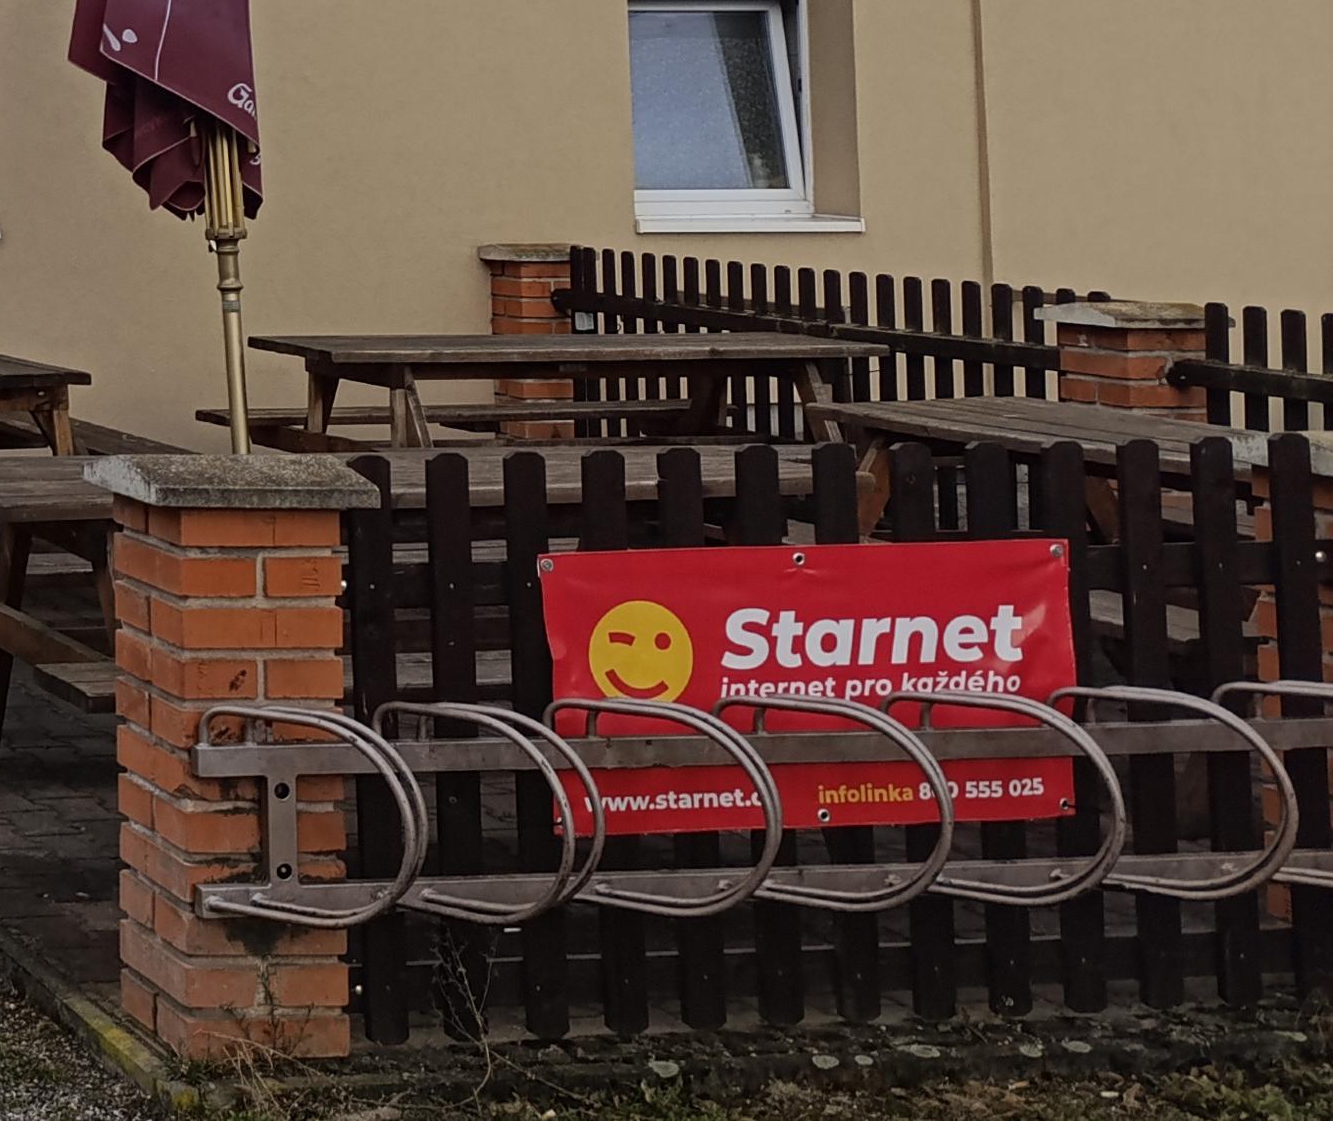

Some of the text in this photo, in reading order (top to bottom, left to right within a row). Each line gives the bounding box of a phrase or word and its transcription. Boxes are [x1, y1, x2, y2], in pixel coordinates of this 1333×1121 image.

[720, 604, 1024, 671] Starnet
[720, 670, 1021, 702] internet pro každého
[818, 777, 1045, 804] infolinka 80 555 025
